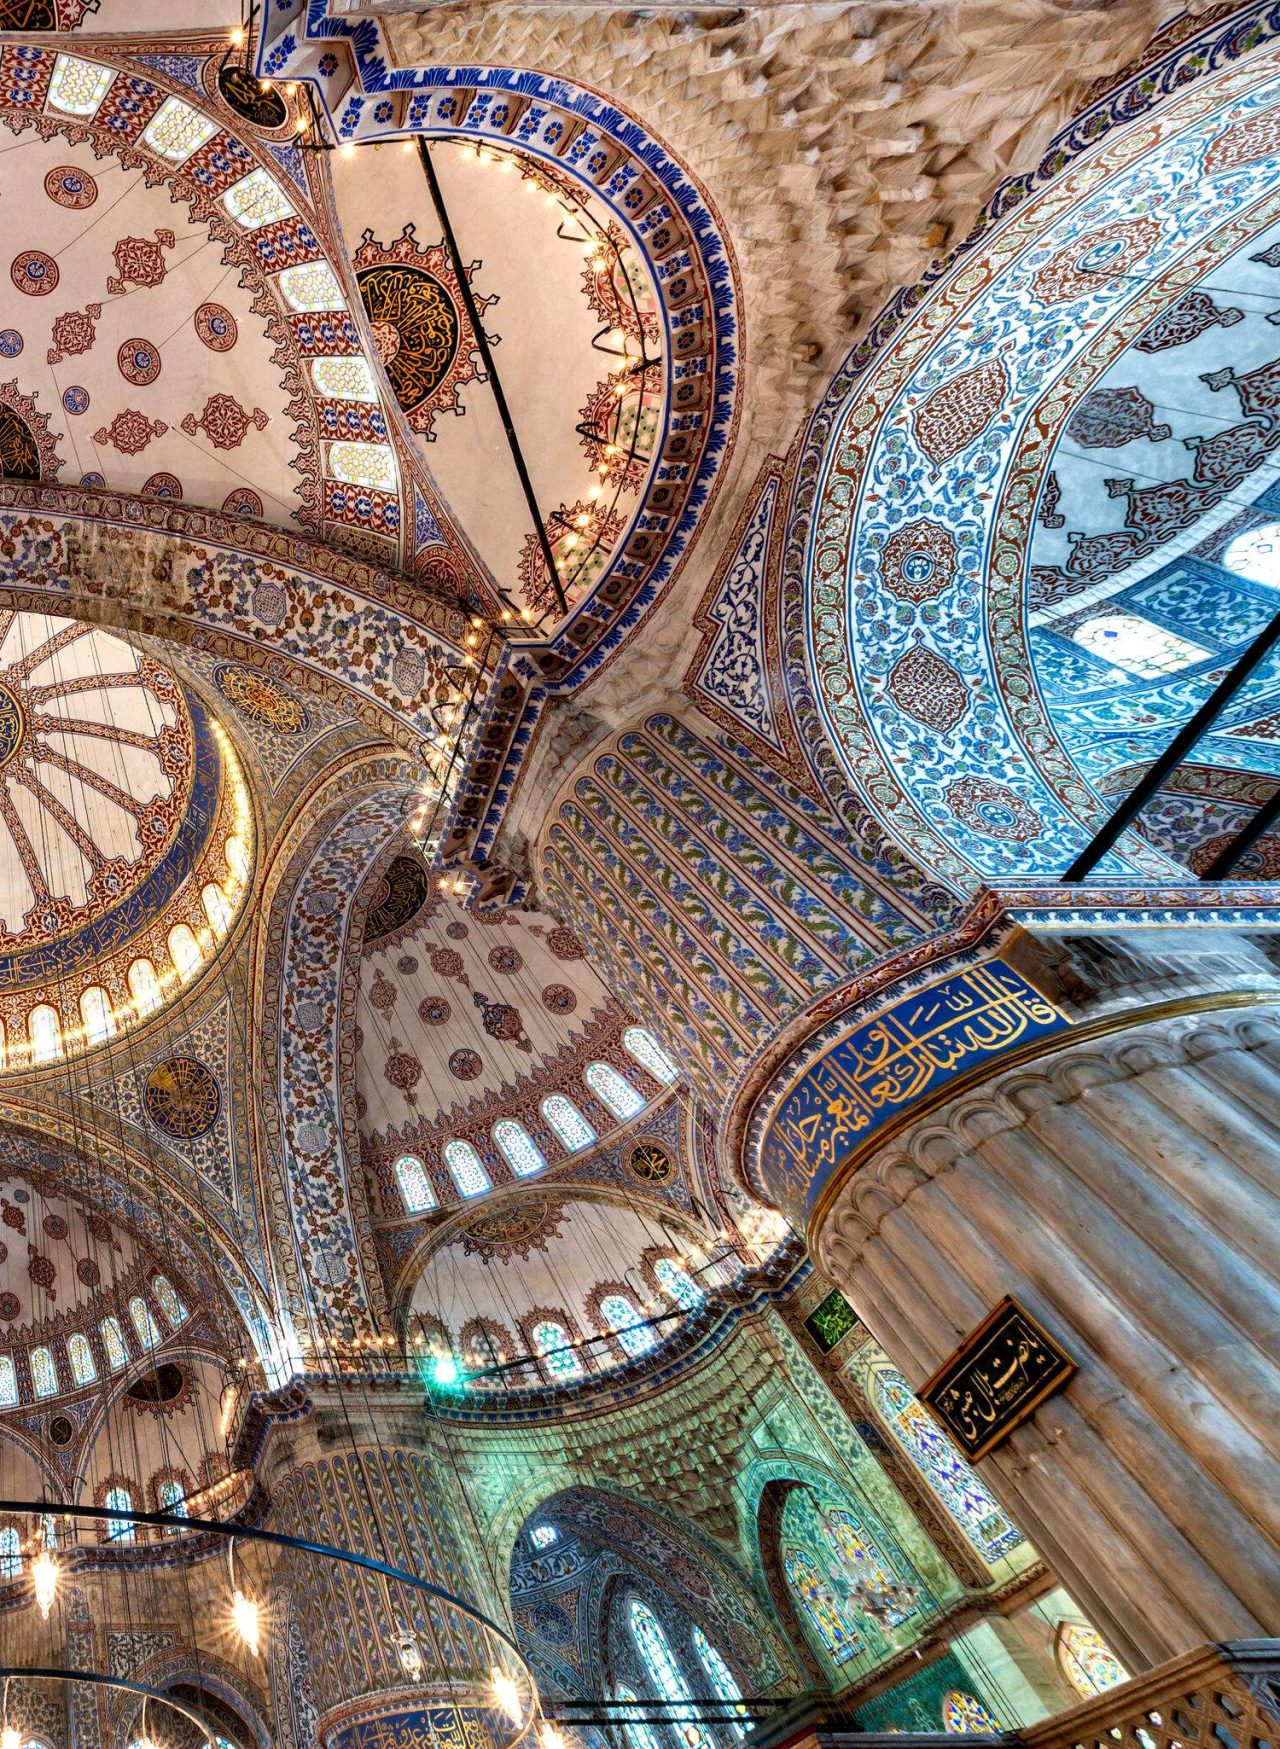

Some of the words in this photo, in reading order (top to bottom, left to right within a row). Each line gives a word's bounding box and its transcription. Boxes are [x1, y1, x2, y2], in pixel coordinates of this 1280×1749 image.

[992, 1338, 1031, 1389] حضرت
[1017, 1326, 1046, 1365] يا
[970, 1368, 1002, 1422] بلال
